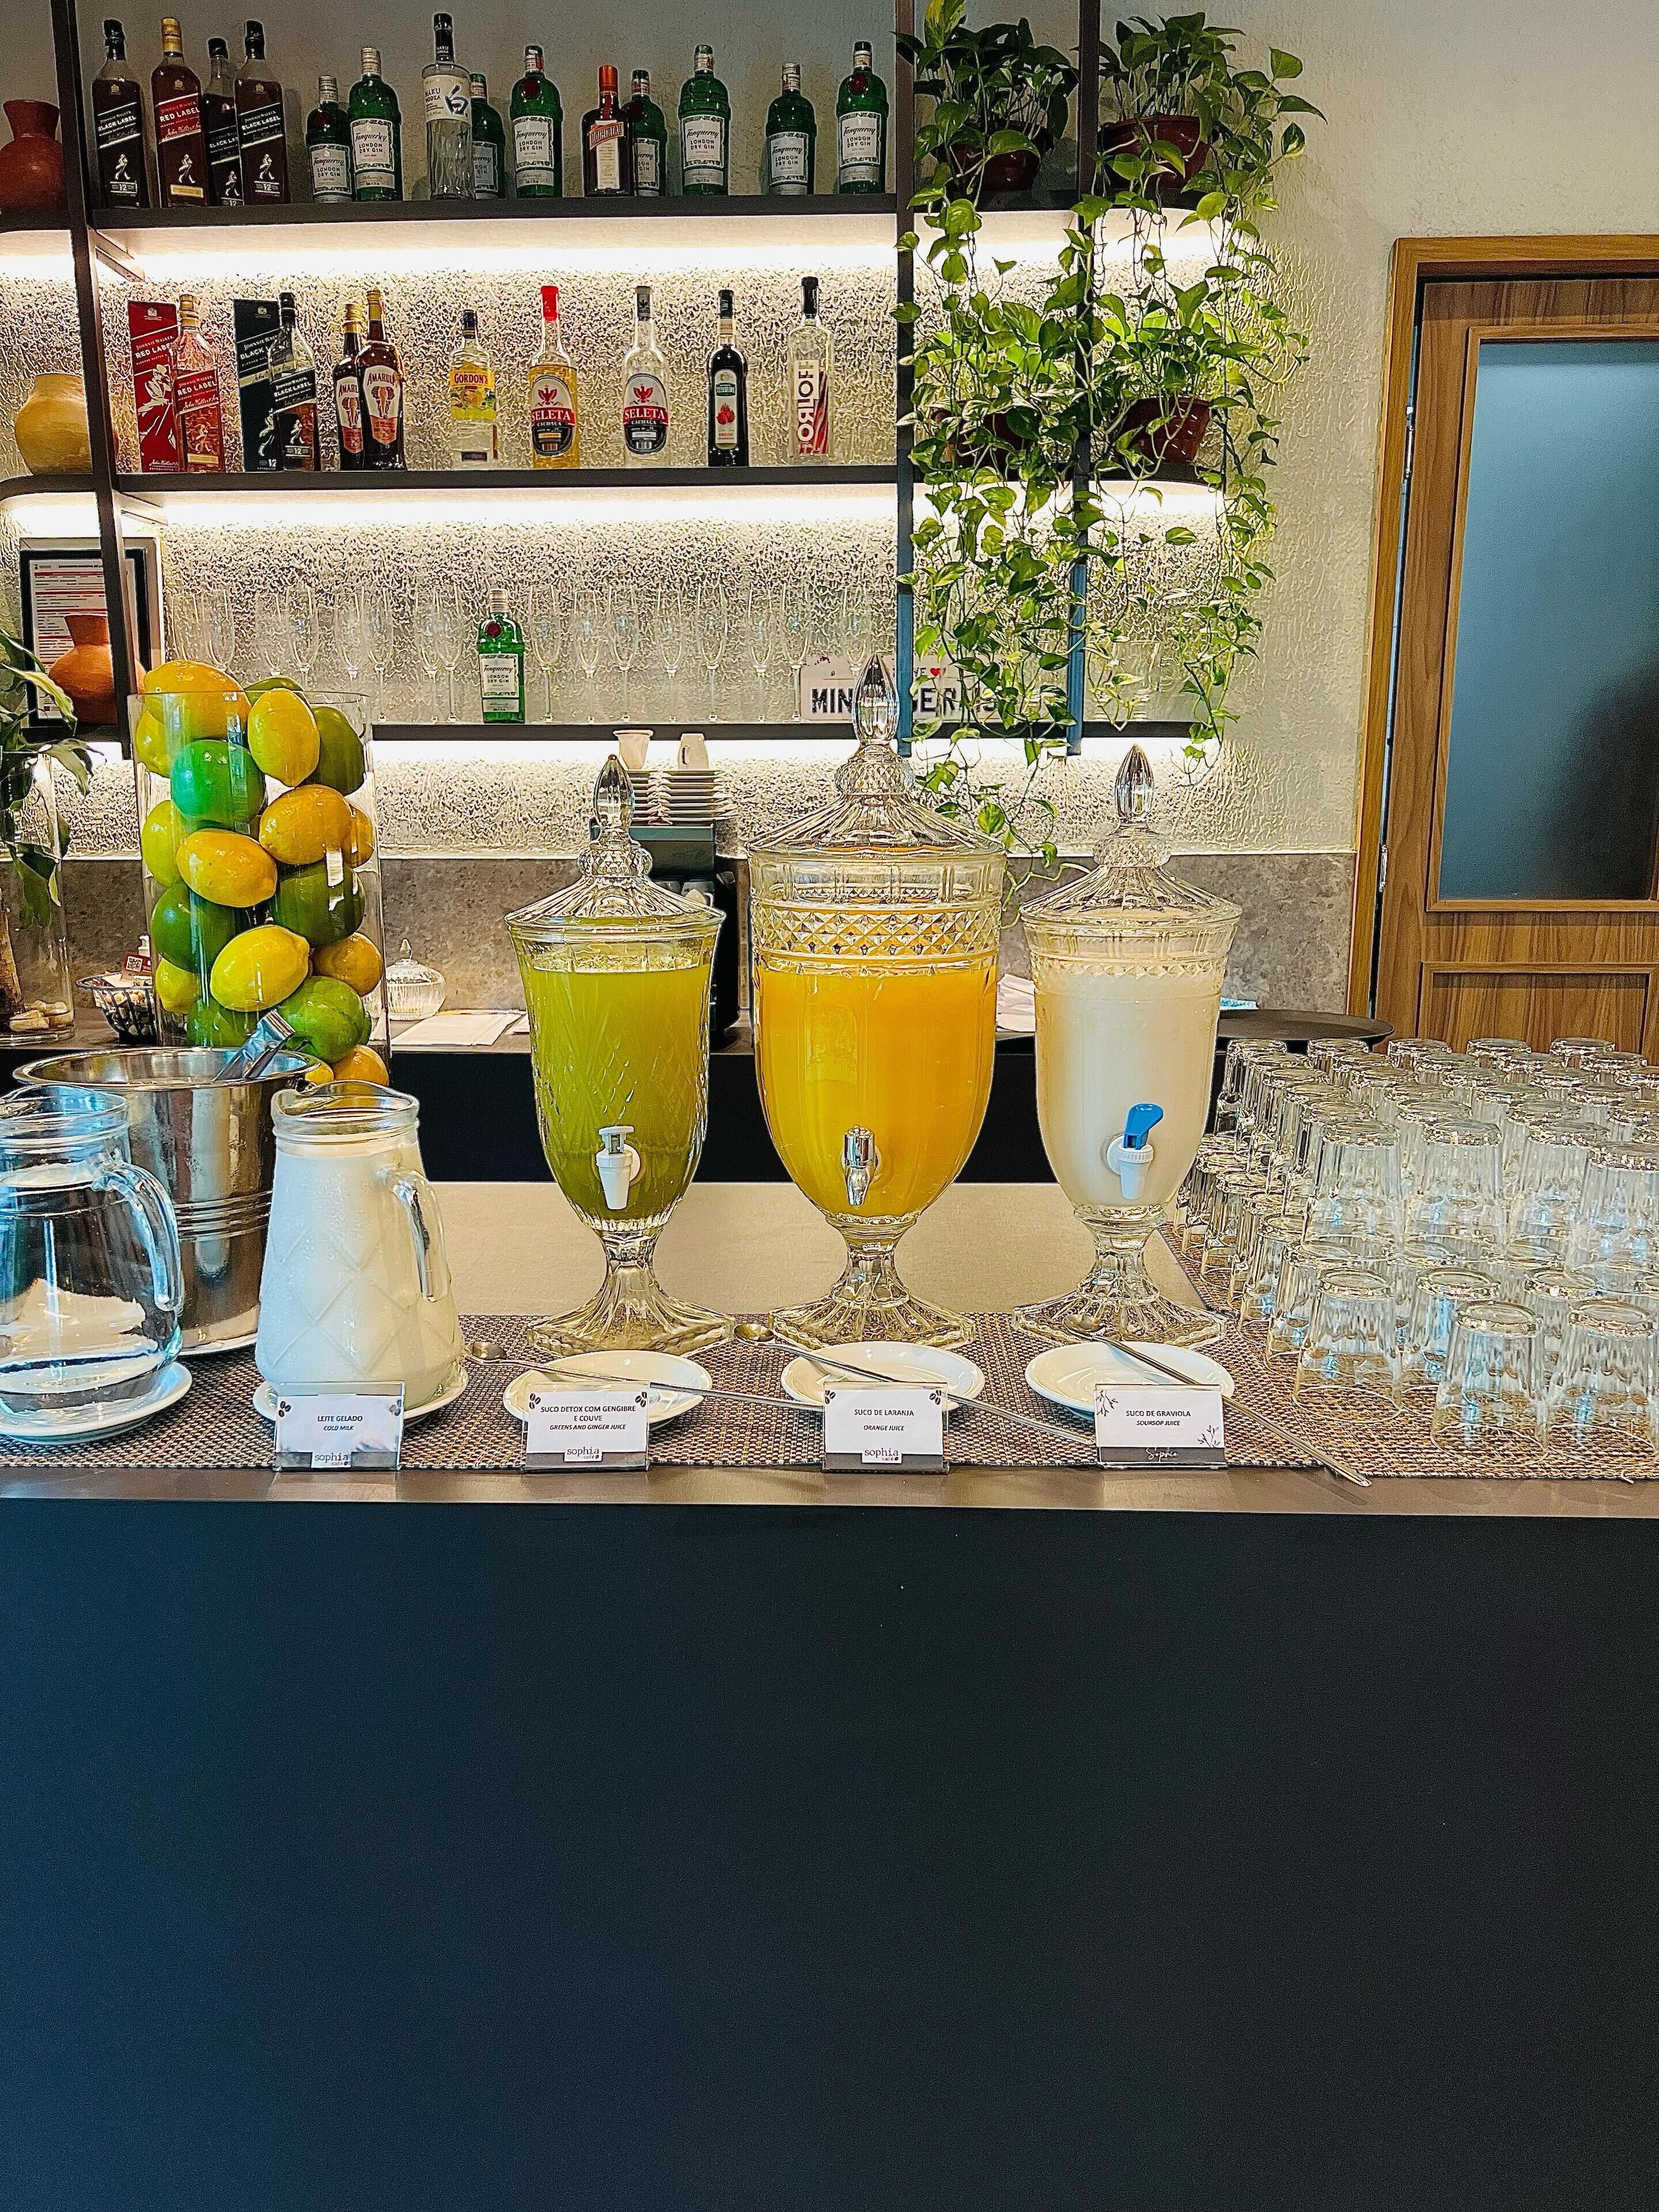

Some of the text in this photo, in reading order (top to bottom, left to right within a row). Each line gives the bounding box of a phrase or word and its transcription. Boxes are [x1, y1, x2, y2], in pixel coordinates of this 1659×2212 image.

[160, 113, 175, 123] RED
[176, 107, 200, 118] LABEL
[98, 122, 116, 131] BLACK
[117, 116, 137, 125] LABEL
[241, 122, 261, 130] BLACK
[262, 115, 281, 124] LABEL
[244, 339, 264, 350] JOHNNIE
[135, 349, 151, 359] RED
[240, 347, 264, 359] BLACK
[177, 387, 192, 396] RED
[193, 381, 217, 391] LABEL
[274, 387, 293, 397] BLACK
[293, 382, 313, 391] LABEL
[532, 410, 571, 421] SELETA
[624, 408, 665, 419] SELETA
[567, 1446, 599, 1457] sophia
[864, 1448, 899, 1458] sophia
[1146, 1447, 1177, 1463] Sophia
[315, 1453, 349, 1463] sophia
